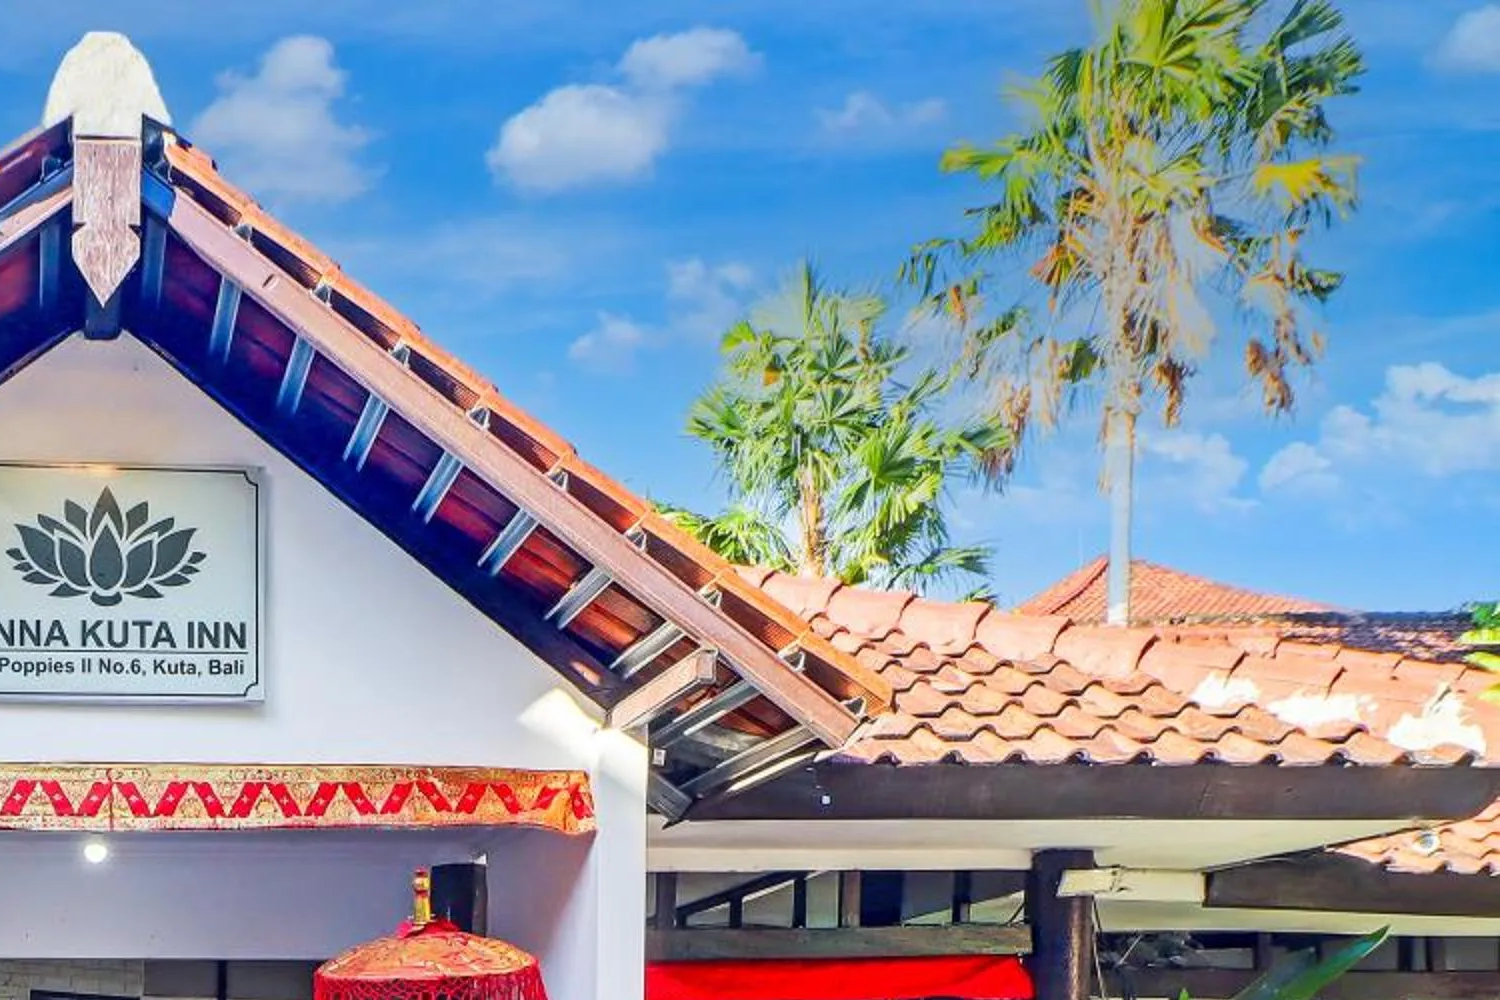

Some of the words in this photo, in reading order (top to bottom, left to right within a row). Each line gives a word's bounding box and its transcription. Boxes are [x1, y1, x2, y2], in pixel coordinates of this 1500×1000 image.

[81, 619, 177, 649] KUTA
[187, 621, 247, 650] INN
[81, 657, 92, 673] II
[100, 658, 147, 677] No.6,
[153, 659, 201, 677] Kuta,
[209, 658, 245, 675] Bali
